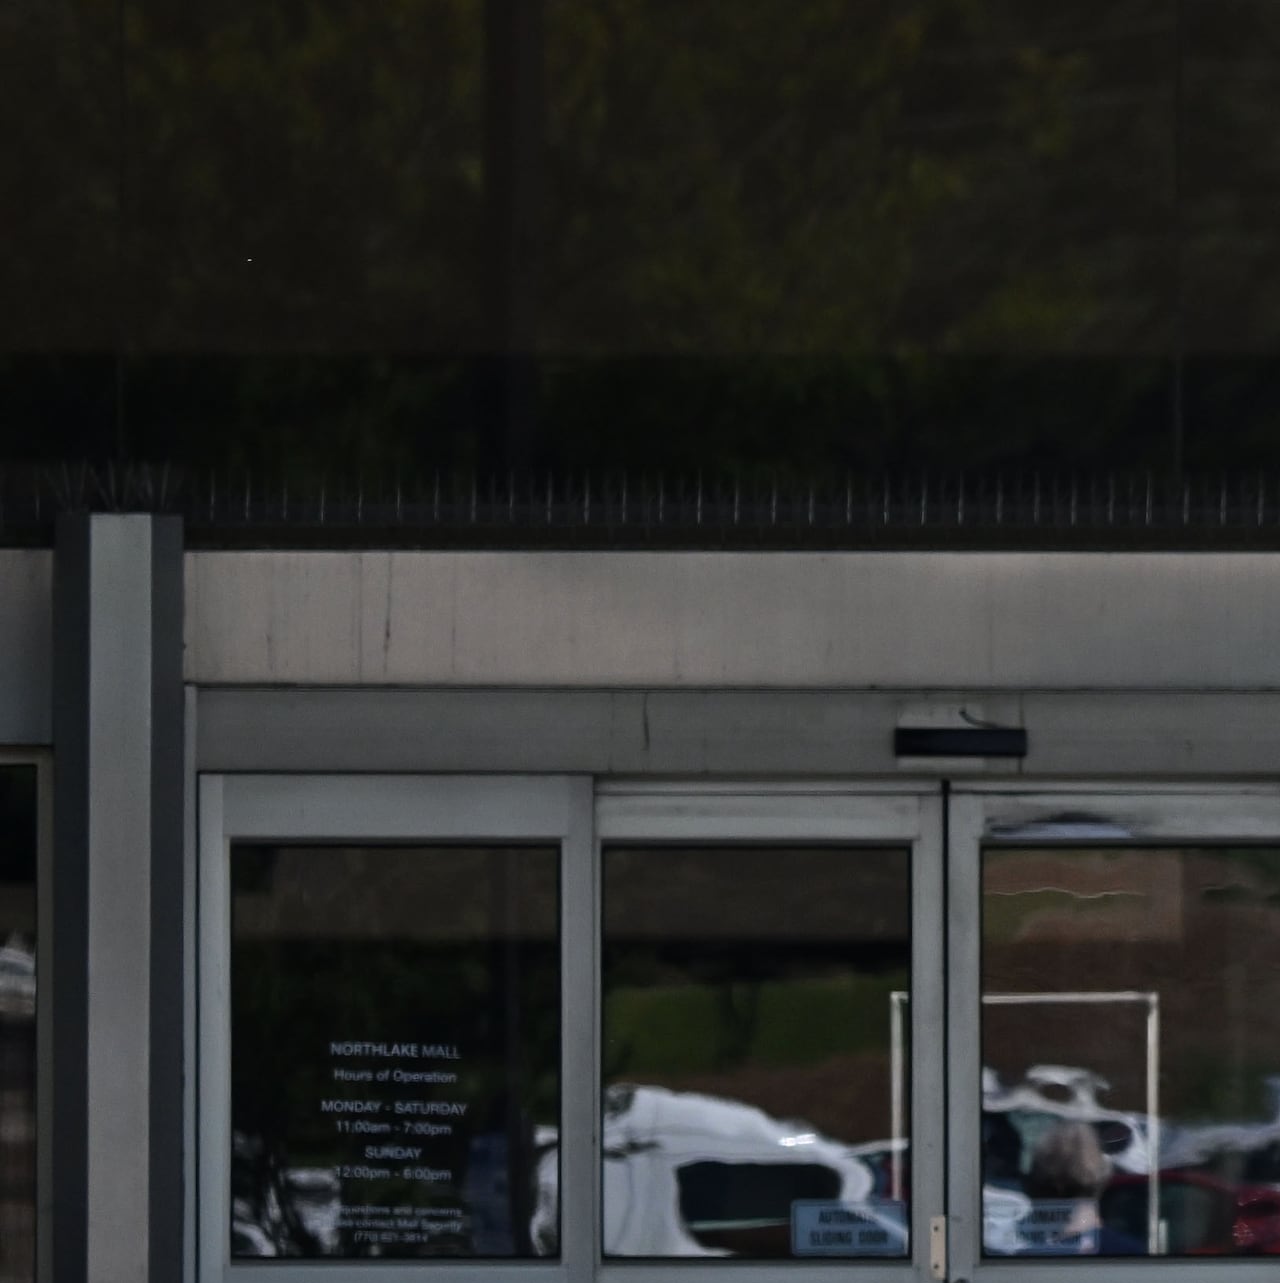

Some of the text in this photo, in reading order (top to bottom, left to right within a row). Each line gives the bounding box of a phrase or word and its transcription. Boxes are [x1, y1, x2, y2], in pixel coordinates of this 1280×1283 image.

[330, 1041, 462, 1060] NORTHLAKE MALL
[333, 1068, 457, 1085] Hours of Operation
[321, 1100, 382, 1114] MONDAY
[394, 1101, 468, 1116] SATURDAY
[336, 1121, 391, 1135] 11:00am
[403, 1122, 452, 1137] 7:00pm
[364, 1146, 422, 1160] SUNDAY
[336, 1166, 391, 1182] 12:00pm
[403, 1167, 452, 1182] 6:00pm
